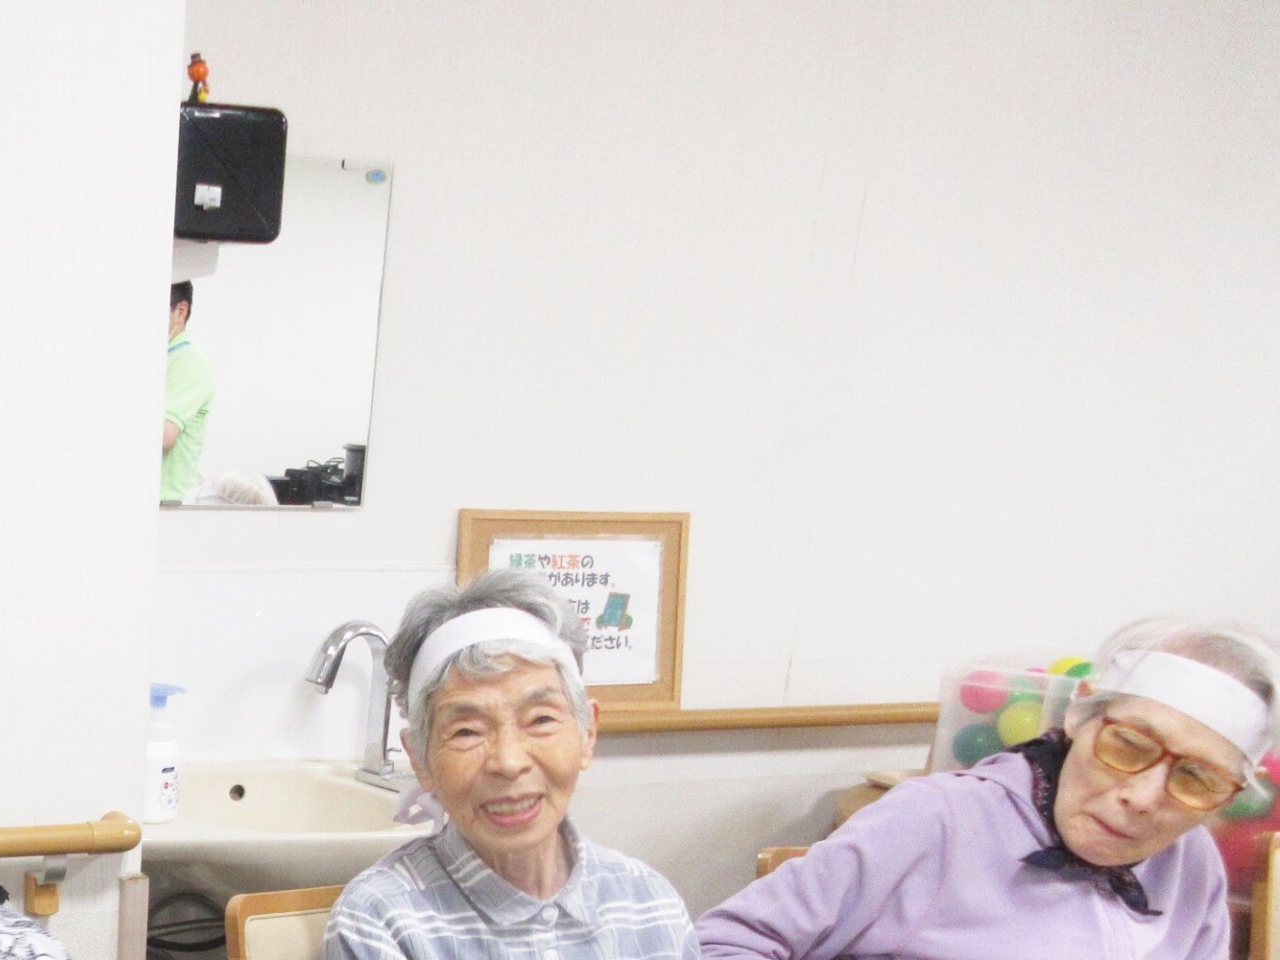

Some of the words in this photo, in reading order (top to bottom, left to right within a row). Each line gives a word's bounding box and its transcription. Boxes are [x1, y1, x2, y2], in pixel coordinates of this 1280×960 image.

[509, 553, 594, 569] 緑茶や紅茶の
[544, 571, 616, 588] があります。
